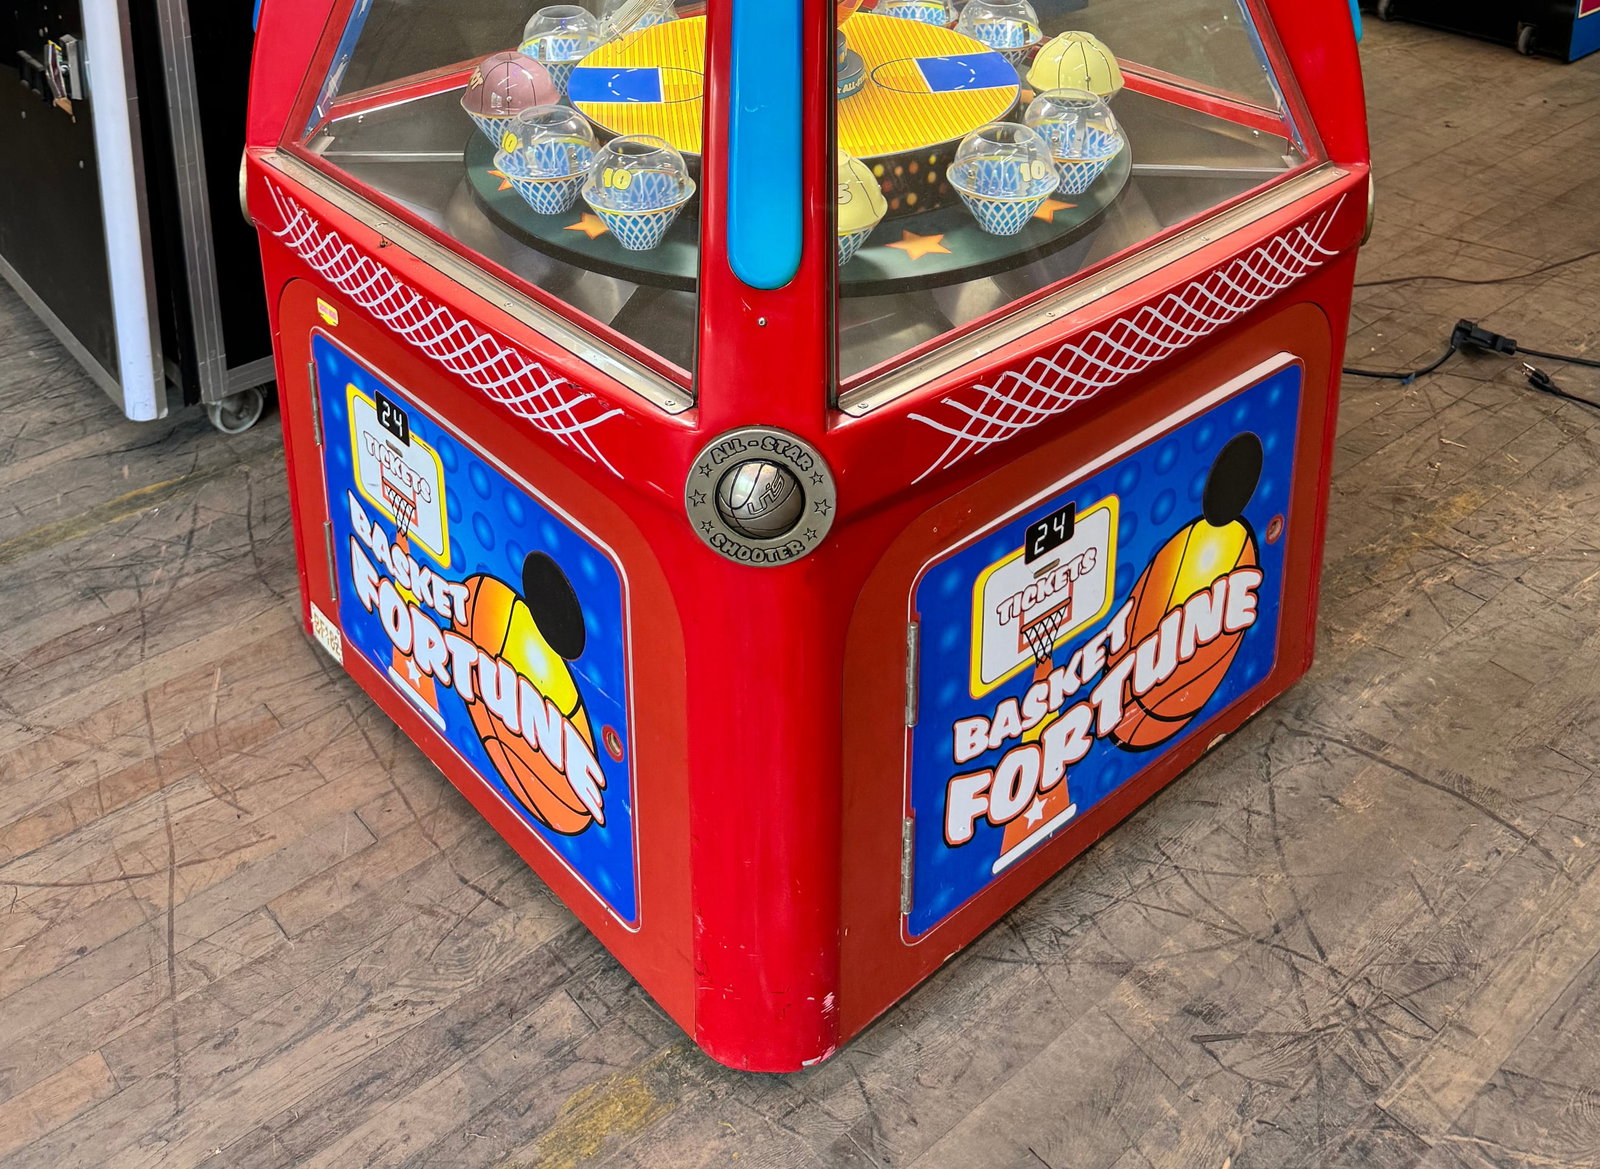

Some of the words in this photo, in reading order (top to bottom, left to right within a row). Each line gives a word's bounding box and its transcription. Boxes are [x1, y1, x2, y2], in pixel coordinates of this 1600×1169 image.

[603, 167, 633, 190] 10
[1019, 160, 1046, 182] 10
[381, 400, 403, 436] 24
[363, 430, 432, 504] TICKETS
[348, 488, 470, 626] BASKET
[709, 533, 805, 563] SHOOTER
[1033, 512, 1065, 554] 24
[996, 547, 1097, 626] TICKETS
[350, 534, 607, 828] FORTUNE
[943, 568, 1263, 847] FORTUNE
[953, 596, 1134, 764] BASKET
